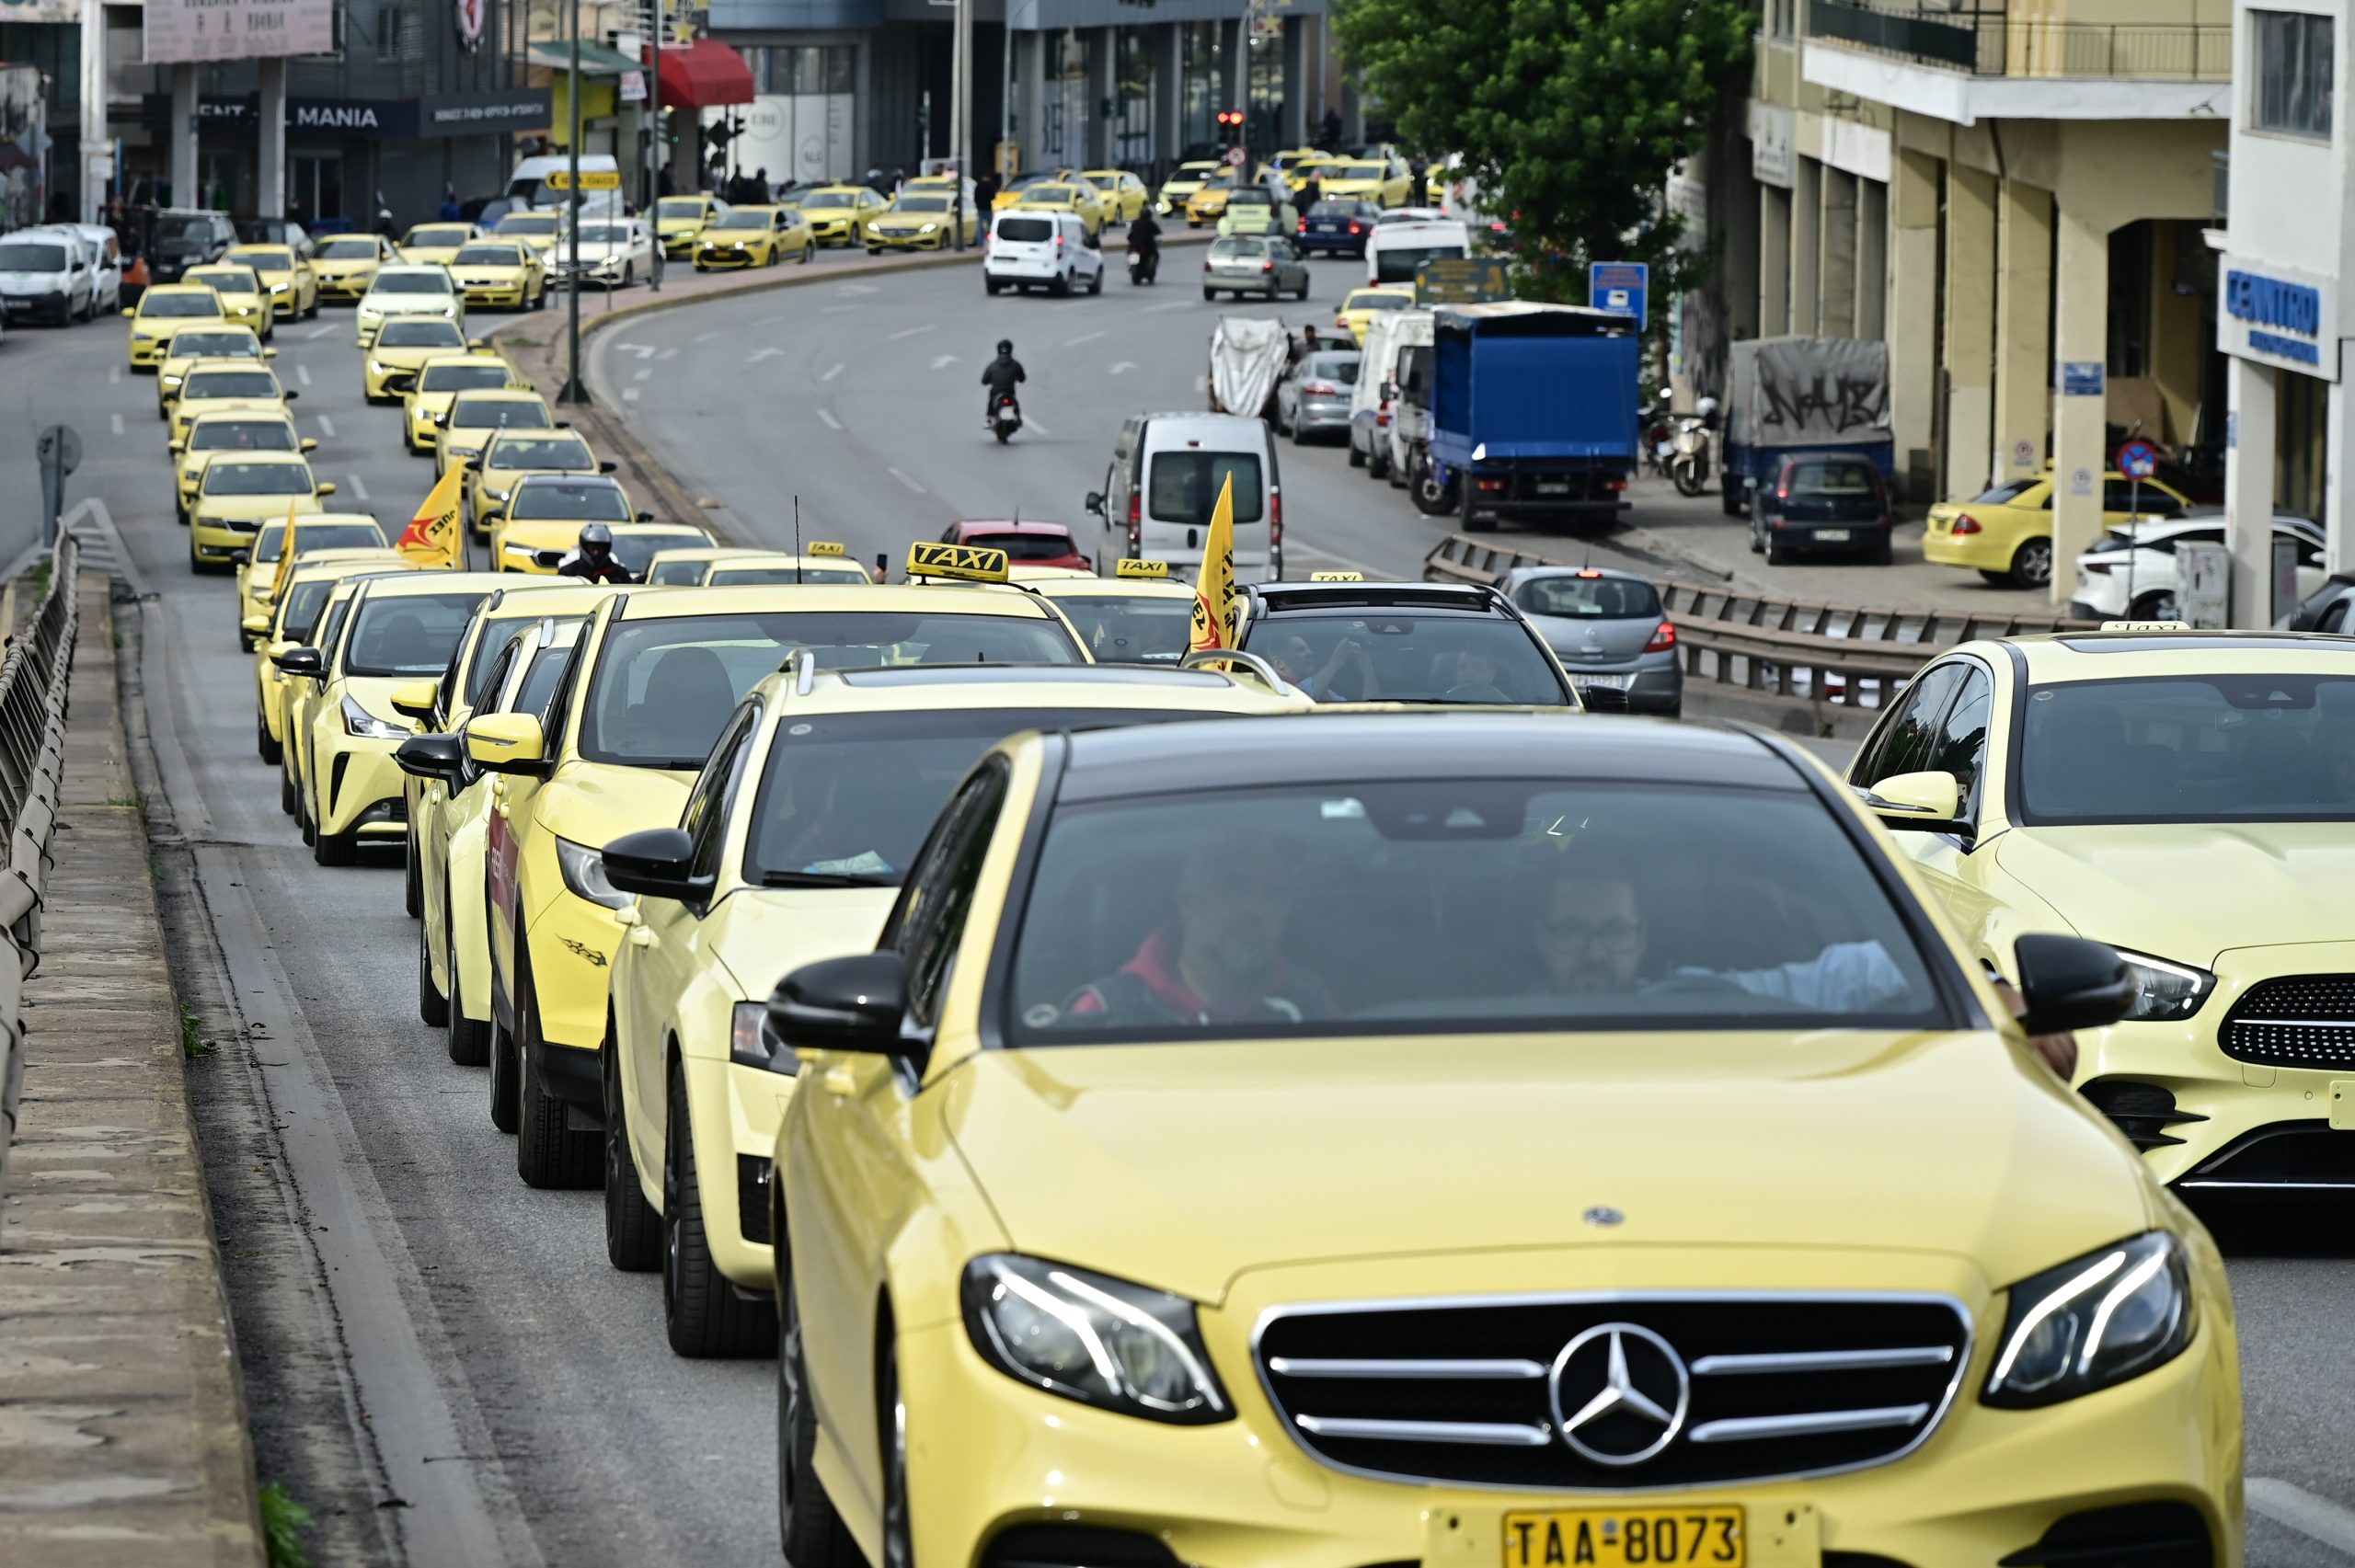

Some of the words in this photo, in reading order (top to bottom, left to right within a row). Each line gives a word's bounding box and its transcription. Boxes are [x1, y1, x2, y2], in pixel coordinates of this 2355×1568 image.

[297, 106, 378, 127] MANIA
[811, 544, 842, 553] TAXI
[918, 544, 999, 570] TAXI
[1122, 560, 1163, 571] TAXI
[1512, 1516, 1737, 1566] TAA-8073
